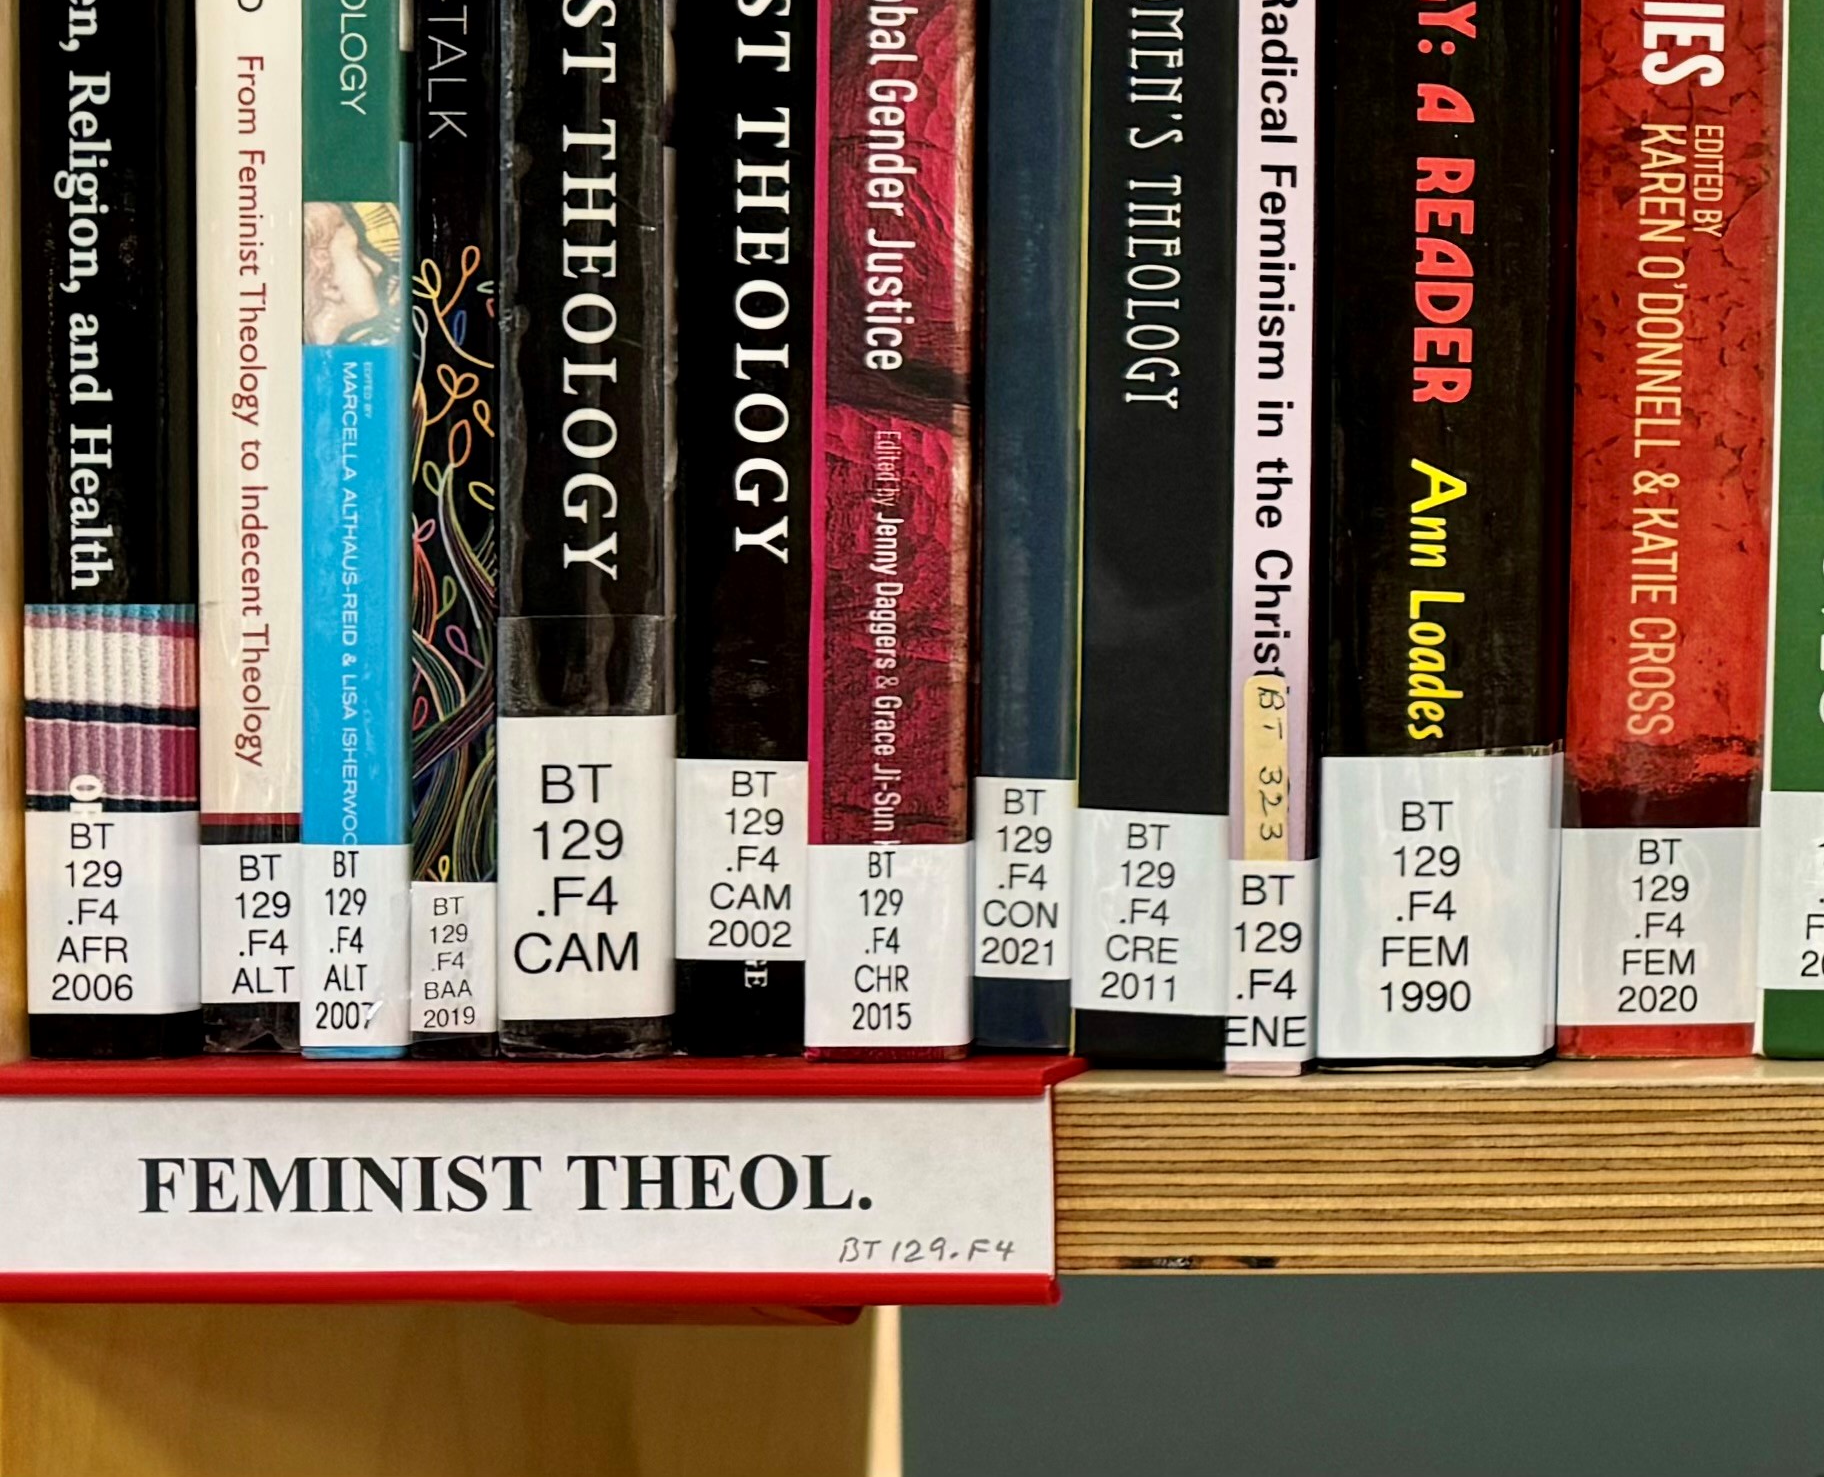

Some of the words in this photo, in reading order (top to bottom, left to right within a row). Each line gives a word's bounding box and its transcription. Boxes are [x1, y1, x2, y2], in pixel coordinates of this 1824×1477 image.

[236, 55, 264, 133] From
[1417, 84, 1475, 123] A
[53, 70, 113, 292] Religion,
[866, 75, 918, 216] Gender
[236, 150, 266, 274] Feminist
[864, 226, 909, 372] Justice
[1125, 177, 1181, 411] THEOLOGY
[1413, 155, 1475, 405] READER
[68, 315, 113, 405] and
[231, 283, 267, 427] Theology
[563, 121, 618, 580] THEOLOGY
[241, 439, 262, 471] to
[68, 423, 113, 590] Health
[1410, 460, 1468, 570] Ann
[239, 483, 268, 616] Indecent
[234, 626, 270, 768] Theology
[1406, 588, 1467, 740] Loades
[66, 861, 122, 888] 129
[71, 824, 114, 849] BT
[68, 899, 118, 926] .F4
[429, 924, 469, 944] 129
[434, 897, 464, 915] BT
[51, 974, 133, 1001] 2006
[57, 936, 129, 964] AFR
[425, 980, 472, 999] BAA
[432, 951, 465, 971] .F4
[424, 1006, 475, 1027] 2019
[138, 1155, 541, 1212] FEMINIST
[567, 1154, 873, 1211] THEOL.
